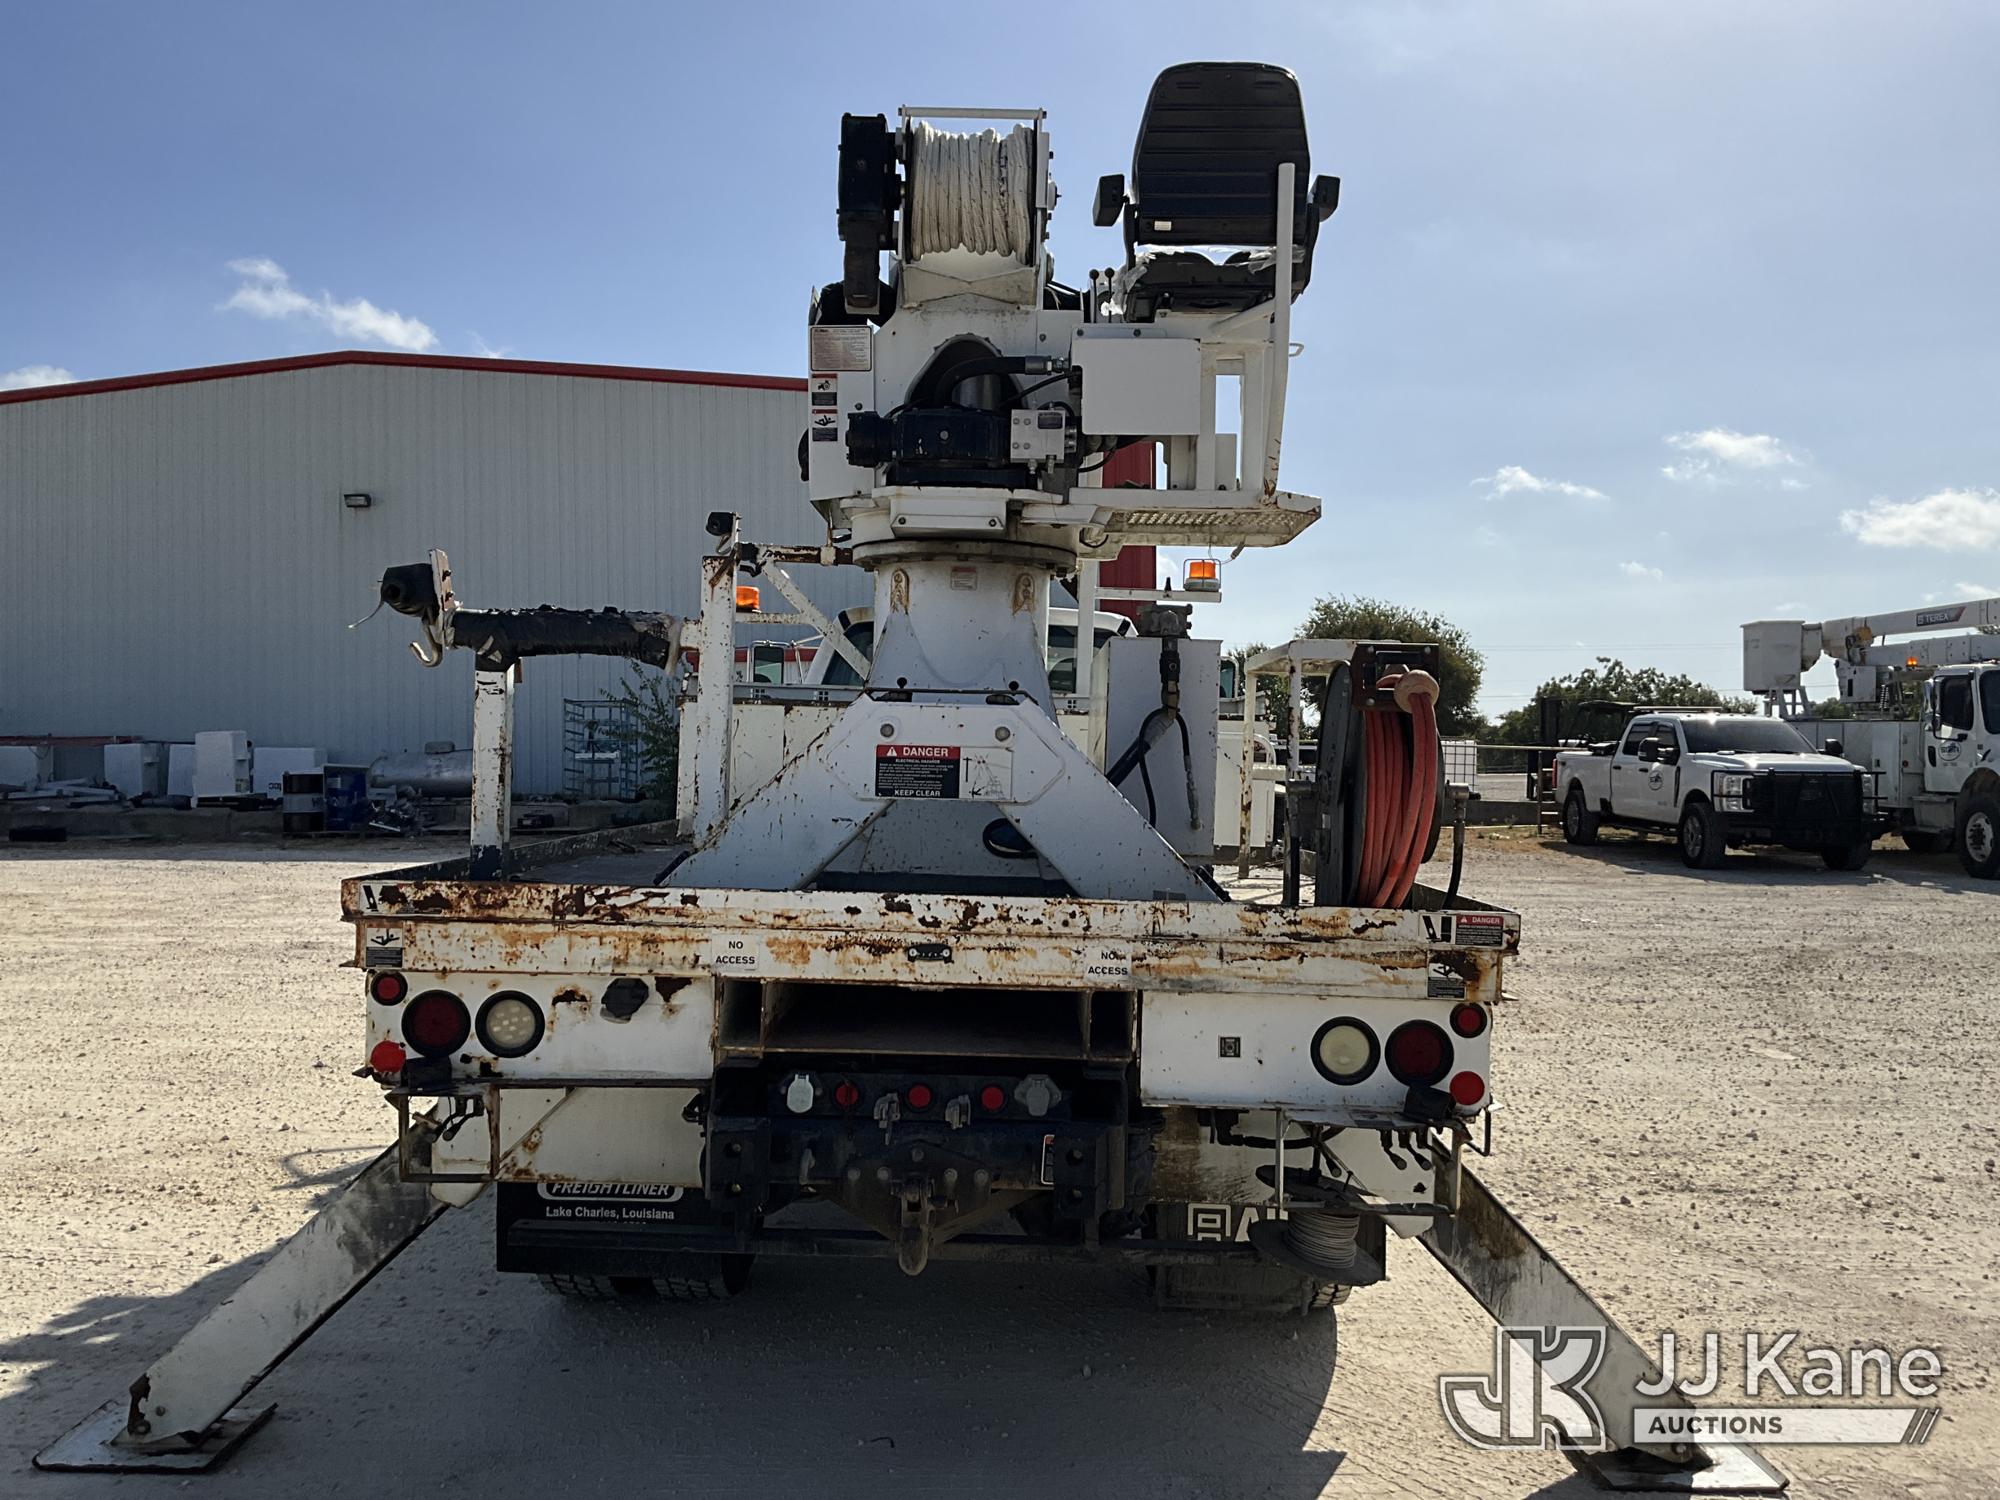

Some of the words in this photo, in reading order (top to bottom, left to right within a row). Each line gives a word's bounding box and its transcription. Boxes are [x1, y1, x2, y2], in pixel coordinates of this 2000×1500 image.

[1926, 613, 1949, 623] TEREX
[903, 747, 949, 757] DANGER
[894, 789, 915, 797] KEEP
[1472, 916, 1500, 924] DANGER
[728, 940, 744, 949] NO
[715, 955, 756, 965] ACCESS
[1101, 951, 1117, 960] NO
[1088, 966, 1128, 975] ACCESS
[551, 1182, 670, 1196] FREIGHTLINER
[545, 1206, 572, 1218] Lake
[575, 1206, 620, 1219] Charles,
[622, 1207, 675, 1220] Louisiana
